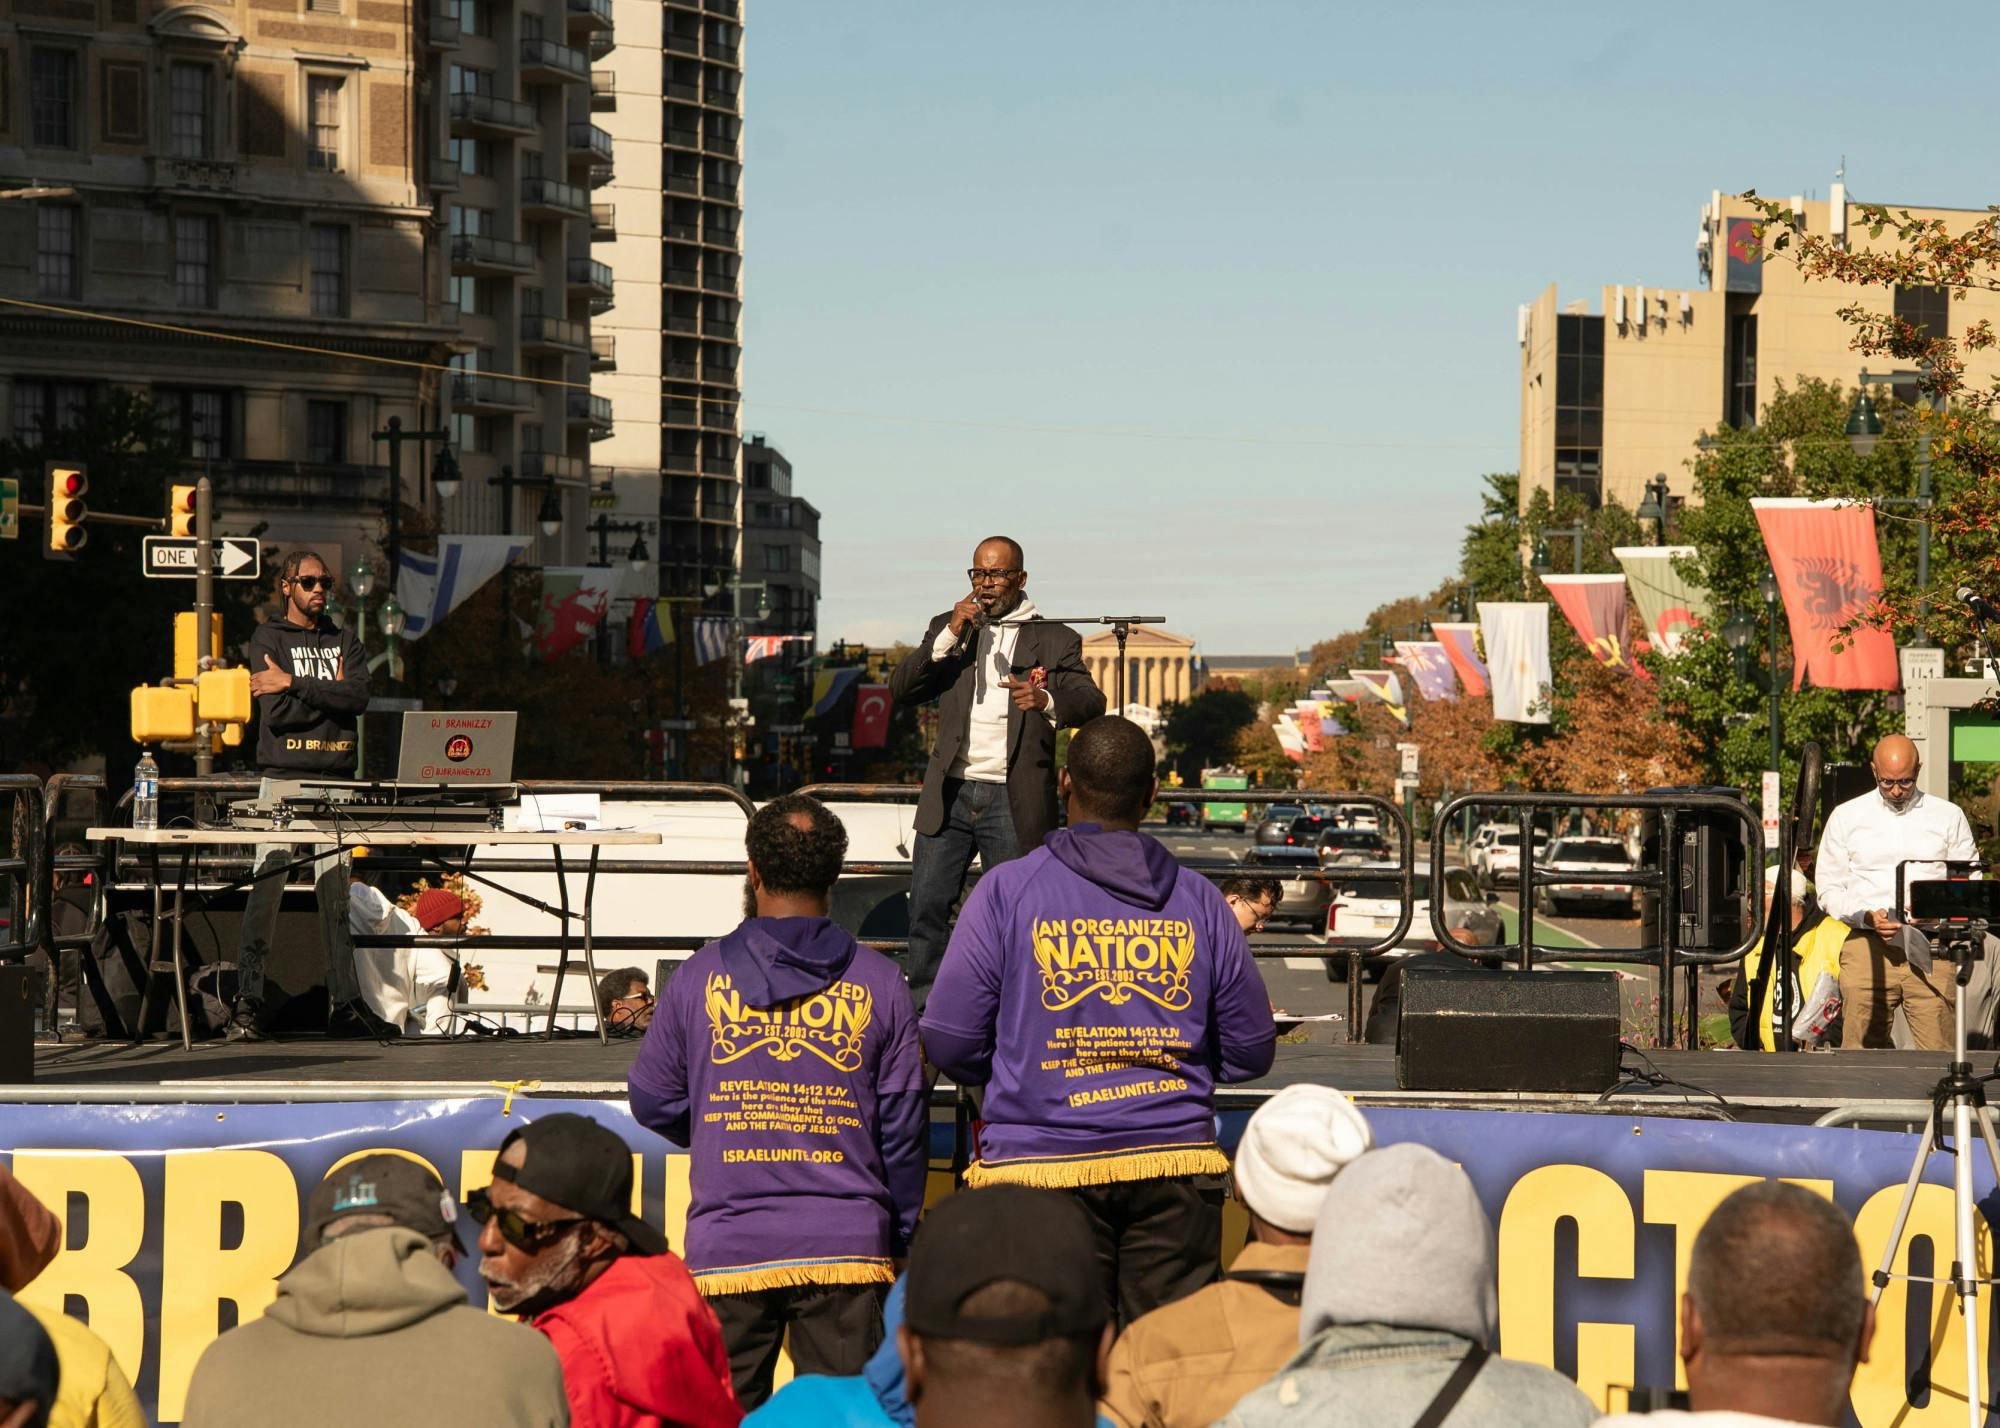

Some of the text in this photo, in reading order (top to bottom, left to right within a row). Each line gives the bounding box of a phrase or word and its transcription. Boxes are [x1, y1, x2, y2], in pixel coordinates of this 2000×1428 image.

[157, 549, 187, 564] ONE
[291, 646, 341, 659] MILLION
[432, 719, 441, 728] DJ
[286, 739, 302, 750] DJ
[1039, 919, 1188, 937] AN ORGANIZED
[1040, 935, 1187, 970] NATION
[1095, 969, 1135, 982] EST.2003
[764, 1025, 807, 1039] EST.2003
[1056, 1027, 1181, 1039] REVELATION 14:12 KJV
[1076, 1038, 1092, 1048] the
[1094, 1038, 1135, 1050] patience
[1137, 1037, 1148, 1047] of
[1149, 1037, 1164, 1047] the
[1076, 1048, 1098, 1057] here
[1100, 1049, 1116, 1057] are
[1118, 1048, 1140, 1059] they
[1142, 1047, 1163, 1057] that
[1062, 1058, 1078, 1069] THE
[1065, 1067, 1085, 1079] AND
[1087, 1064, 1104, 1075] THE
[720, 1080, 848, 1098] REVELATION 14:12 KJV
[1069, 1078, 1188, 1108] ISRAELUNITE.ORG
[709, 1093, 730, 1102] Here
[732, 1092, 740, 1101] is
[742, 1091, 758, 1101] the
[799, 1094, 810, 1104] of
[811, 1095, 826, 1105] the
[741, 1101, 763, 1111] here
[780, 1102, 801, 1115] they
[803, 1104, 823, 1115] that
[724, 1112, 741, 1121] THE
[837, 1117, 862, 1128] GOD,
[726, 1121, 747, 1131] AND
[750, 1121, 767, 1130] THE
[793, 1124, 807, 1133] OF
[809, 1124, 840, 1135] JESUS.
[723, 1148, 844, 1164] ISRAELUNITE.ORG
